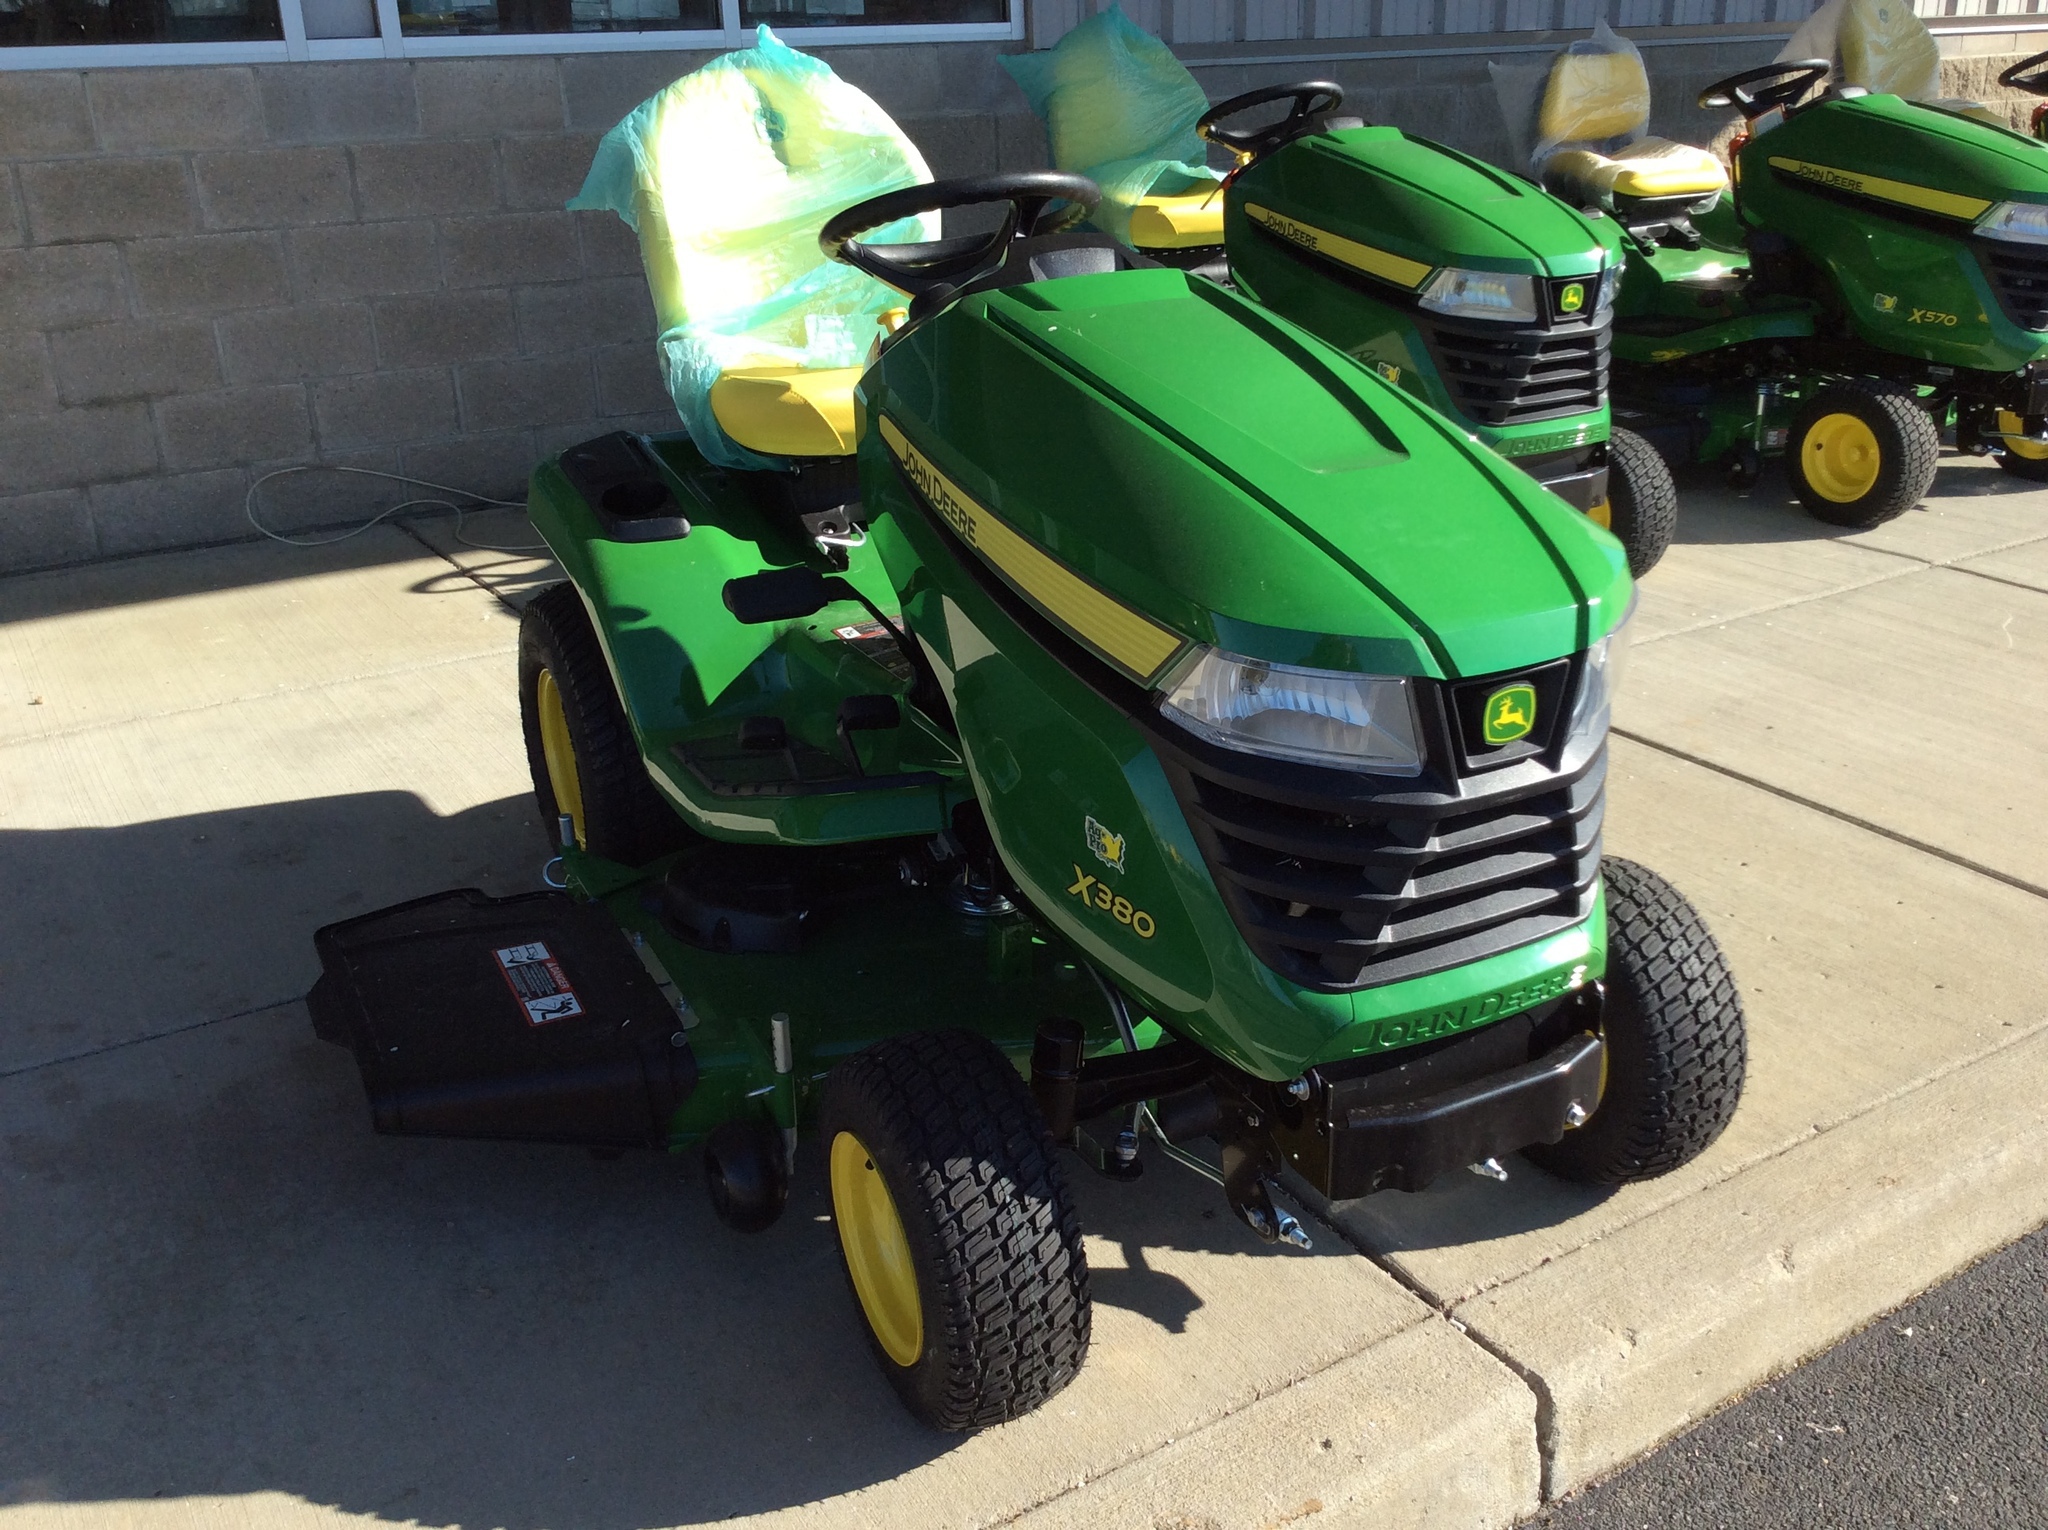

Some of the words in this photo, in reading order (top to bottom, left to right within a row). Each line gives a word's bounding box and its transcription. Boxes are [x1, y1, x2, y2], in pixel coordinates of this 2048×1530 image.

[1796, 163, 1824, 182] JOHN
[1826, 171, 1863, 192] DEERE
[1264, 211, 1287, 234] JOHN
[1287, 222, 1318, 250] DEERE
[1907, 308, 1958, 327] X570
[902, 443, 933, 494] JOHN
[933, 477, 977, 544] DEERE
[1067, 862, 1156, 939] X380
[1352, 1005, 1468, 1053] JOHN
